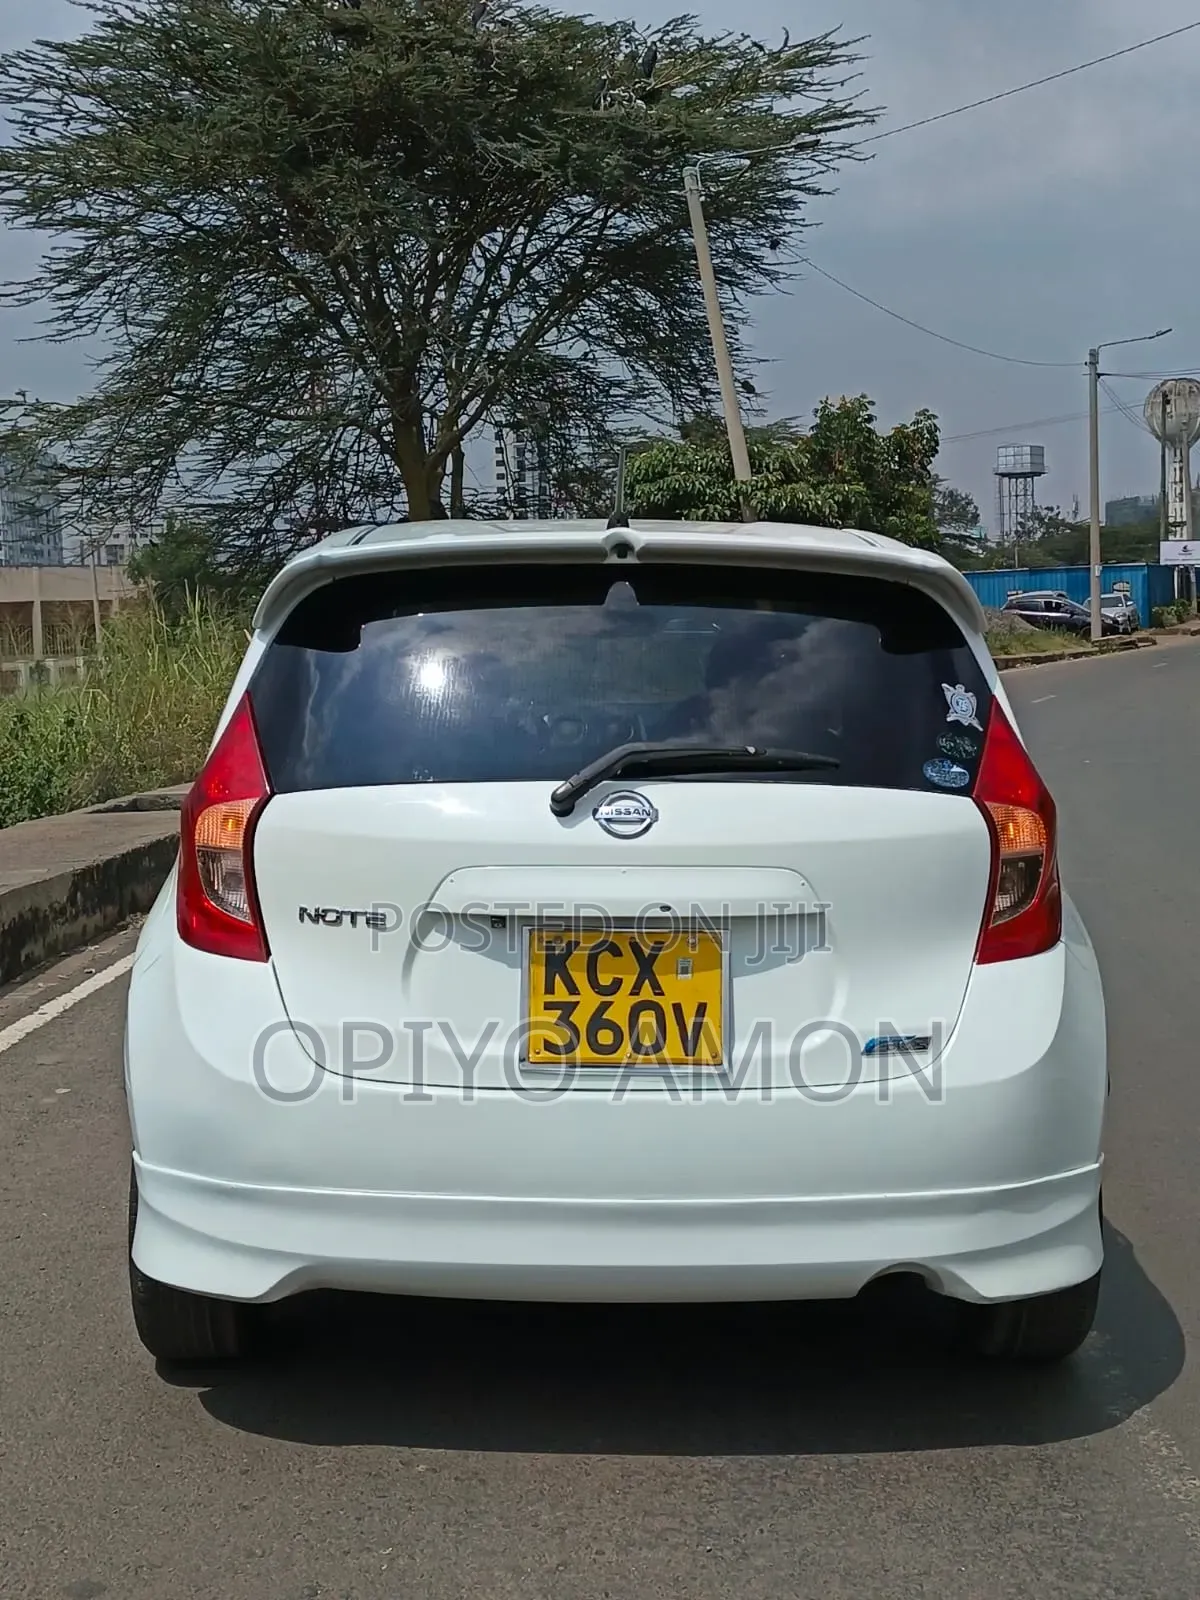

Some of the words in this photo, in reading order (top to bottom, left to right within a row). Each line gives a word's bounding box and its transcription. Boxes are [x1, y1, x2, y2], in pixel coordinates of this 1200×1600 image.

[298, 906, 387, 929] NOTE
[543, 939, 666, 997] KCX
[543, 999, 708, 1057] 360V
